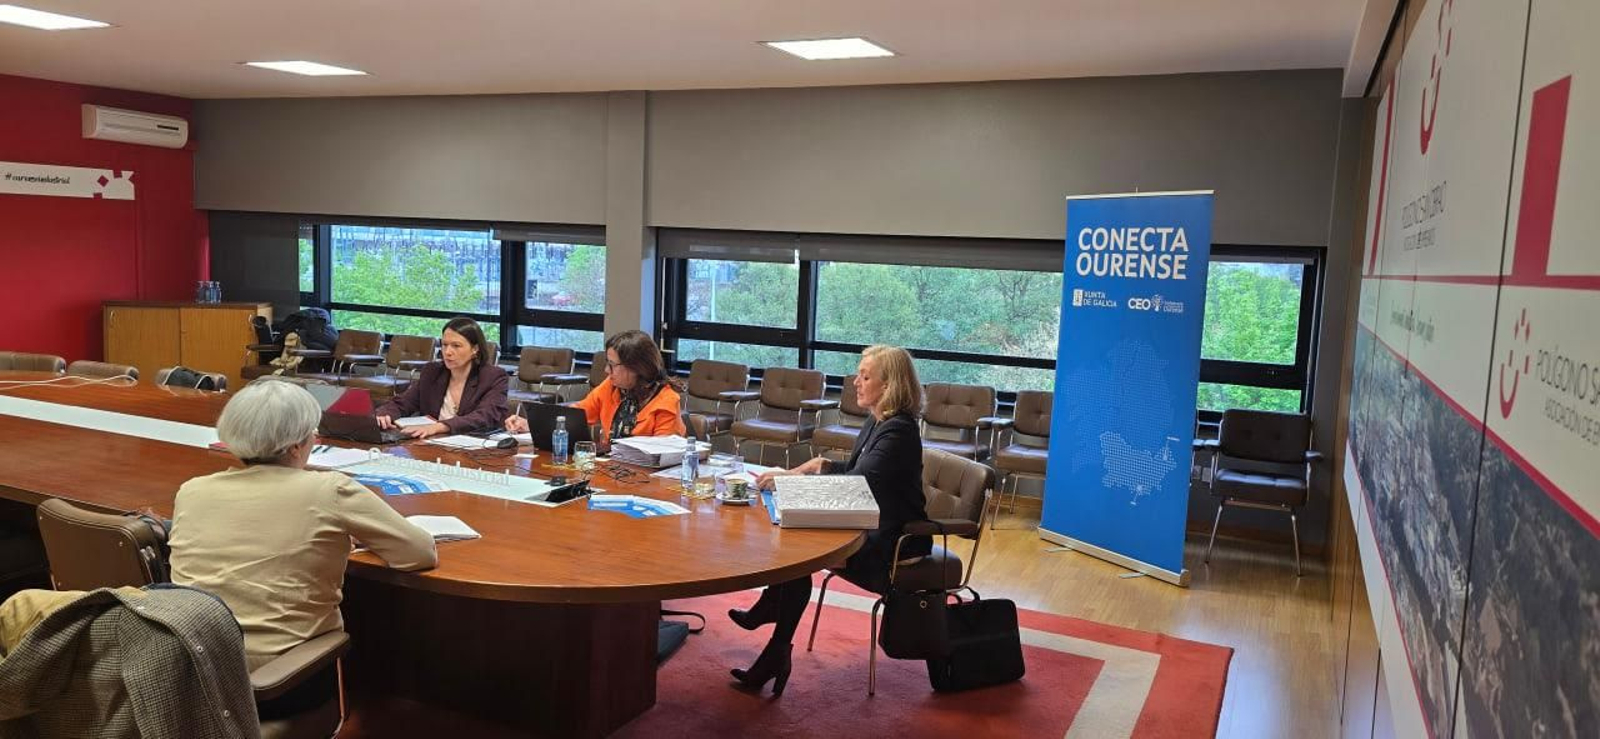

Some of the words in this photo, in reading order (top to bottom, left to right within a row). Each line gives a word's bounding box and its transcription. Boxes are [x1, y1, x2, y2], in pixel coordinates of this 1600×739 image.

[1078, 227, 1189, 251] CONECTA
[1076, 252, 1189, 280] OURENSE
[1084, 290, 1106, 299] XUNTA
[1083, 298, 1091, 306] DE
[1093, 299, 1117, 307] GALICIA
[1128, 297, 1151, 311] CEO
